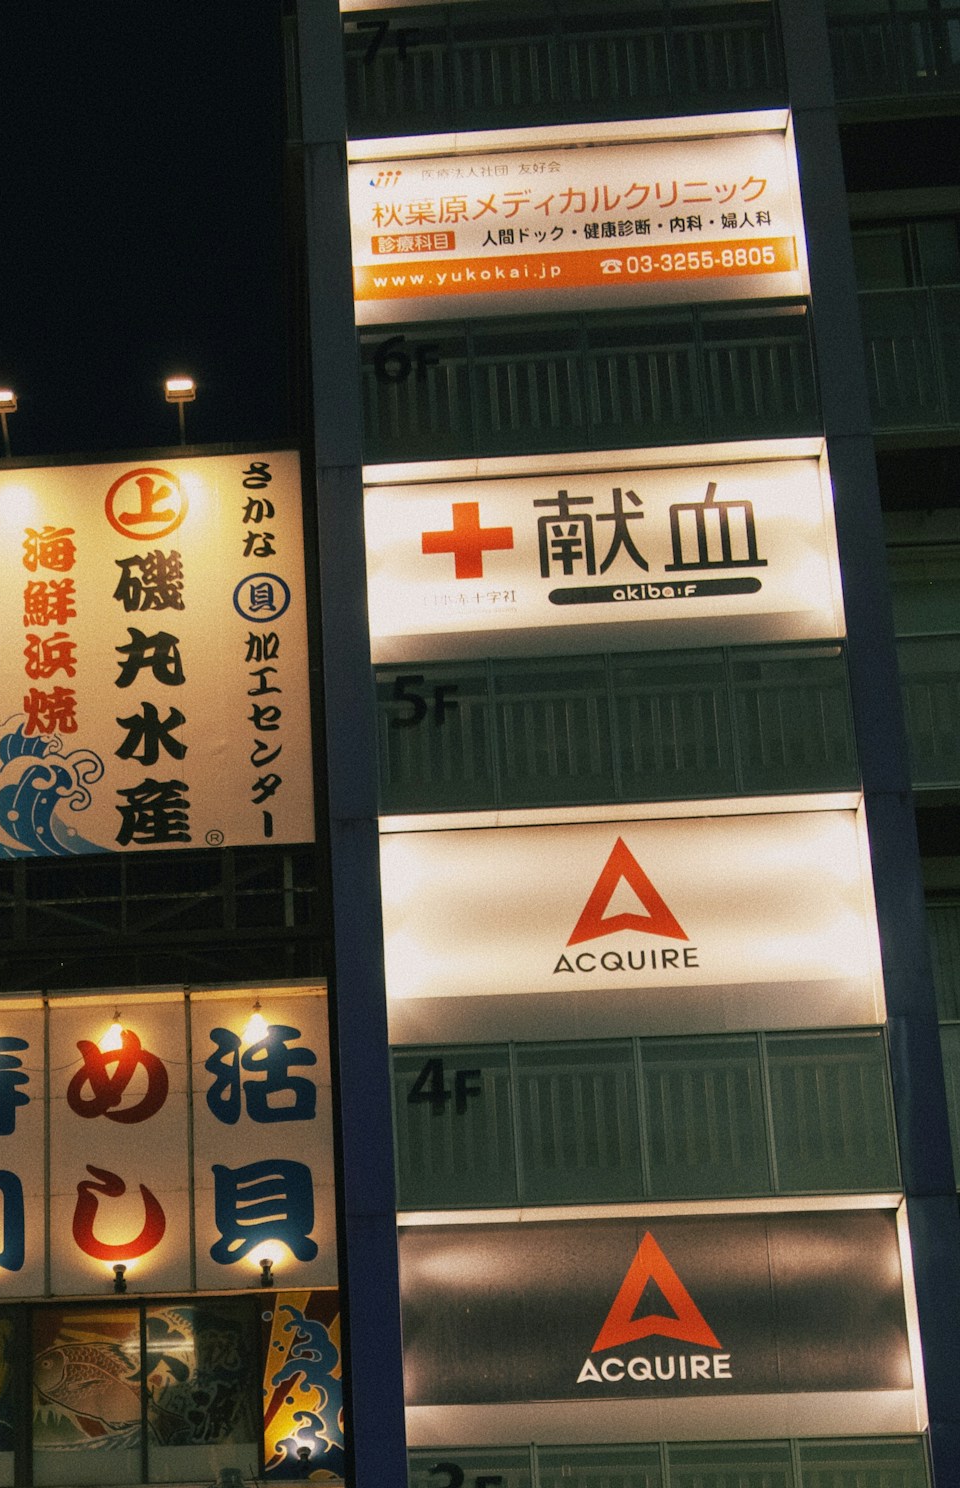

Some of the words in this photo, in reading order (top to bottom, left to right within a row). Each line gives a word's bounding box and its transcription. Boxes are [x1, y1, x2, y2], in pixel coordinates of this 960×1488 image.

[371, 175, 768, 227] 秋葉原メディカルクリニック
[373, 262, 562, 288] www.yukokai.jp
[626, 246, 775, 274] 03-3255-8805
[376, 234, 450, 252] 診療科目
[241, 462, 276, 558] さかな
[533, 481, 768, 578] 献血
[23, 526, 78, 736] 海鮮浜焼
[113, 549, 192, 847] 磯丸水産
[245, 632, 283, 838] 加工センター
[390, 676, 458, 729] 5F
[553, 946, 700, 975] ACQUIRE
[407, 1059, 481, 1117] 4F
[67, 1029, 169, 1261] めし
[205, 1025, 319, 1265] 活貝
[576, 1354, 733, 1384] ACQUIRE
